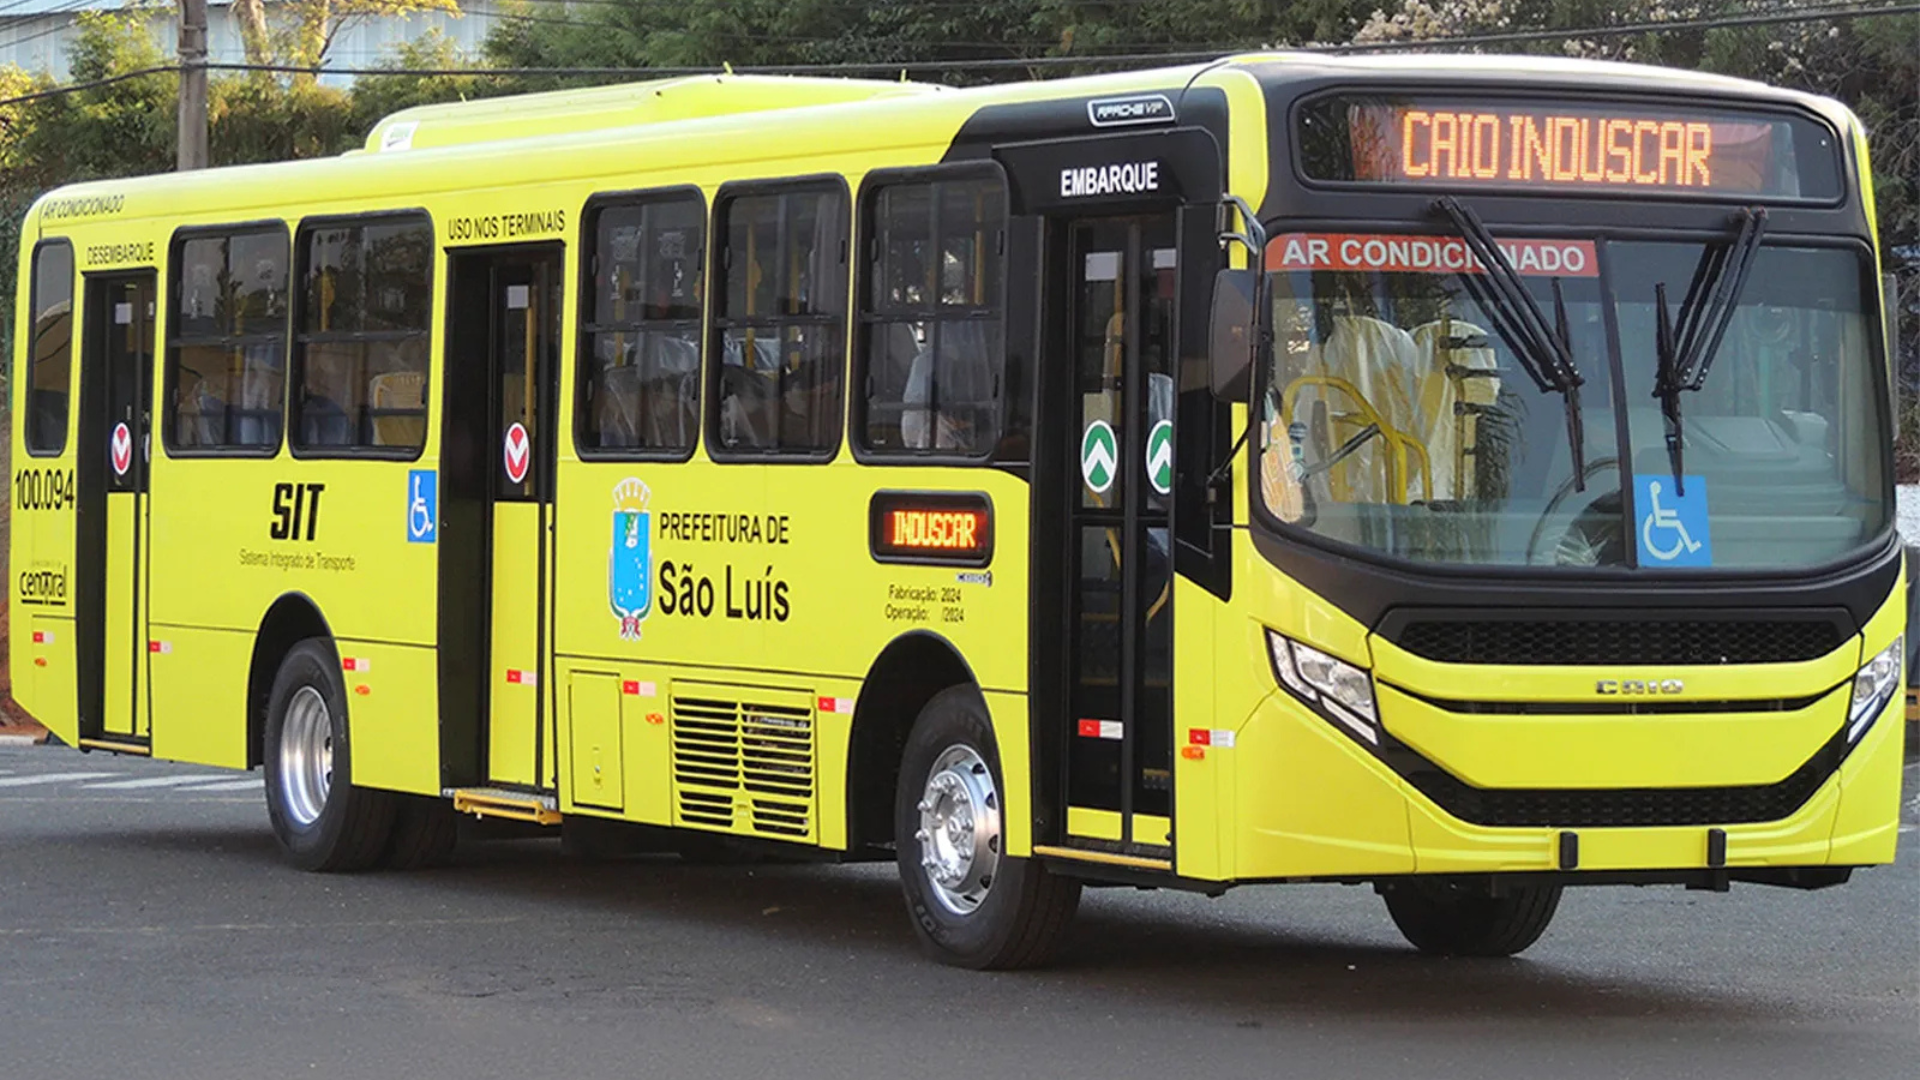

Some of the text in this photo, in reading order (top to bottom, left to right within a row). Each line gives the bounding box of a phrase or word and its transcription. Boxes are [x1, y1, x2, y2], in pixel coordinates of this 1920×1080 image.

[1403, 111, 1712, 187] CAIO INDUSCAR
[1061, 162, 1159, 197] EMBARQUE
[43, 194, 125, 219] AR CONDICIONADO
[448, 209, 566, 240] USO NOS TERMINAIS
[87, 242, 154, 266] DESEMBARQUE
[1282, 239, 1331, 265] AR
[15, 468, 75, 510] 100.094
[270, 482, 325, 541] SIT
[659, 512, 789, 544] PREFEITURA DE
[893, 510, 976, 548] INDUSCAR
[659, 560, 790, 622] São Luís
[888, 584, 961, 603] Fabricação: 2024
[885, 603, 930, 623] Operação:
[1596, 679, 1684, 695] CAIO
